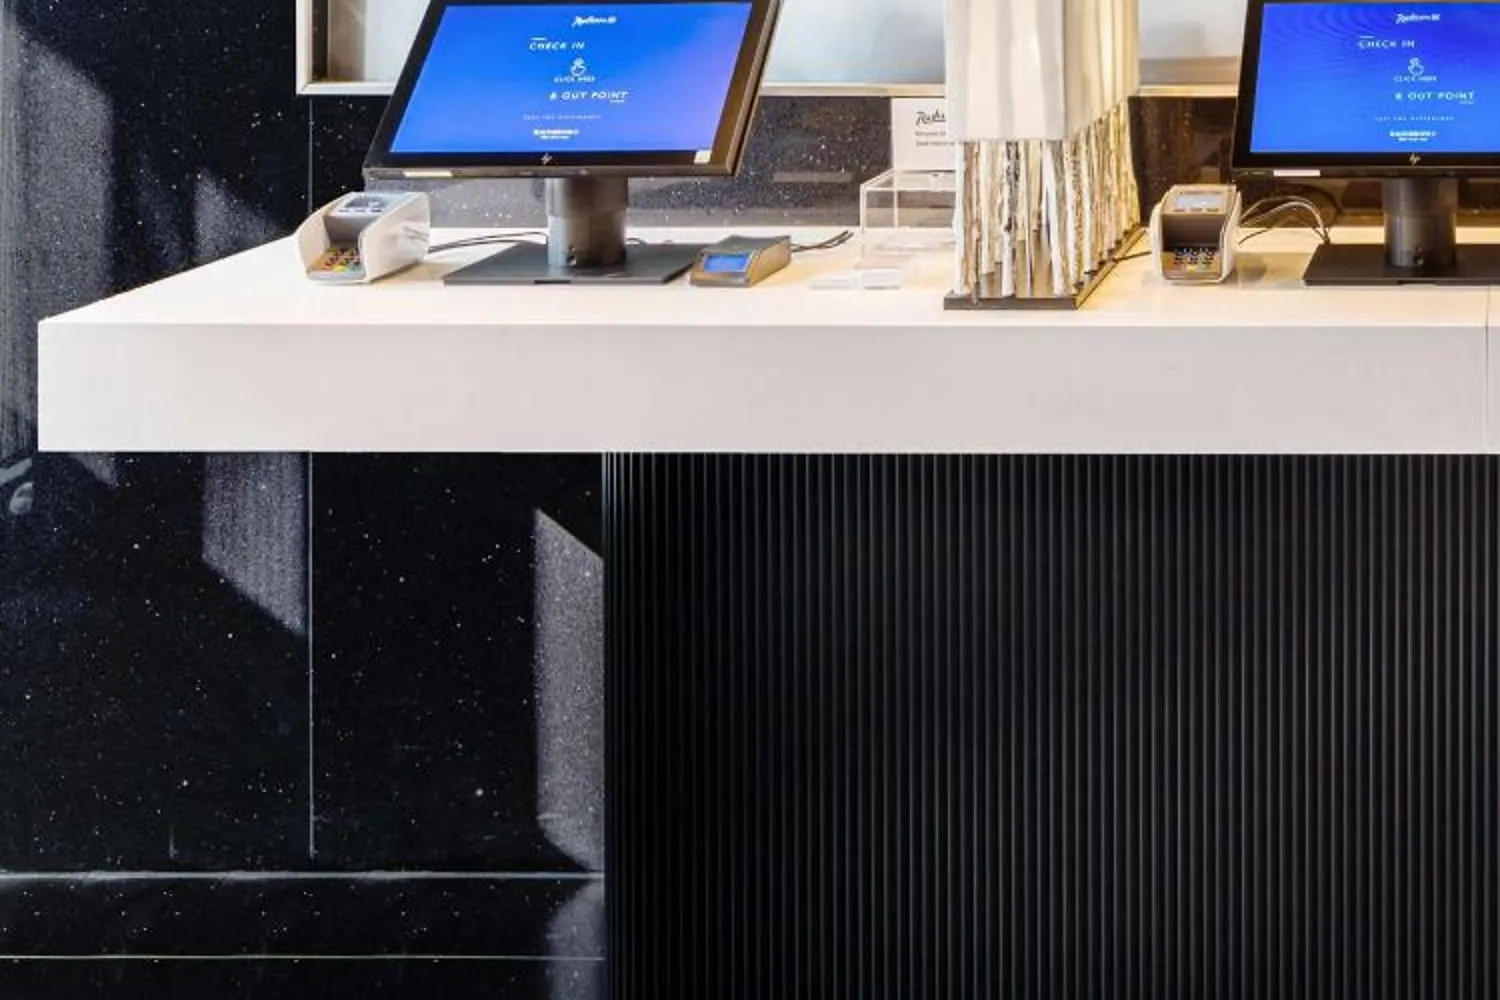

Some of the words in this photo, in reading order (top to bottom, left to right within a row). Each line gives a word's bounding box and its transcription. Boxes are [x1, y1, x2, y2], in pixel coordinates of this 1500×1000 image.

[529, 41, 567, 51] CHECK
[571, 41, 585, 50] IN
[1358, 39, 1397, 49] CHECK
[1401, 39, 1415, 48] IN
[561, 91, 587, 100] OUT
[591, 90, 629, 100] POINT
[1407, 91, 1431, 100] OUT
[1437, 91, 1475, 100] POINT
